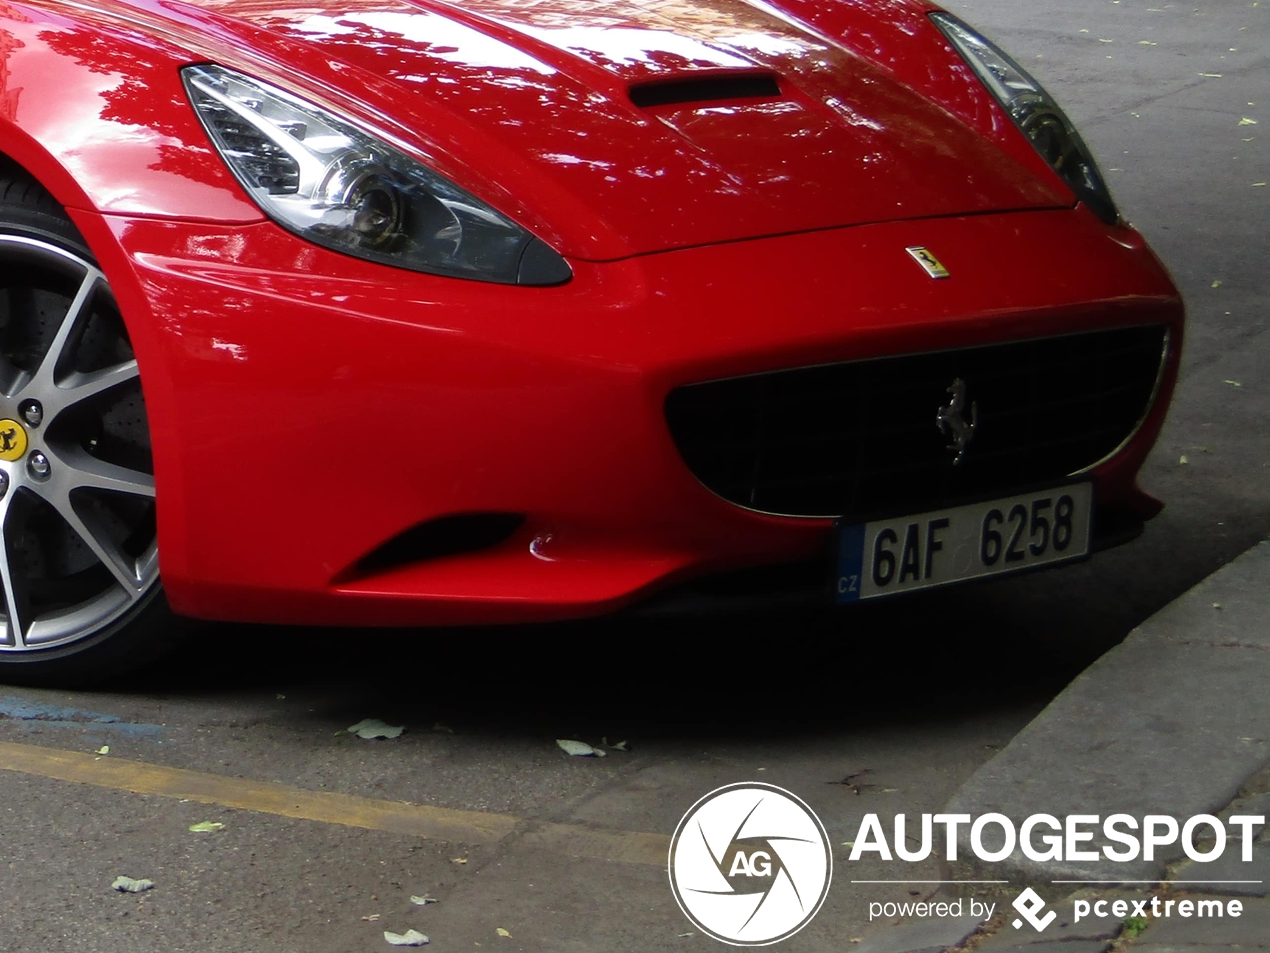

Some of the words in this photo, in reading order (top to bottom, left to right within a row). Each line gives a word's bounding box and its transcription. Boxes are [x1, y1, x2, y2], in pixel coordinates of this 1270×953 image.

[837, 574, 857, 593] CZ
[872, 517, 950, 587] 6AF
[980, 494, 1074, 567] 6258
